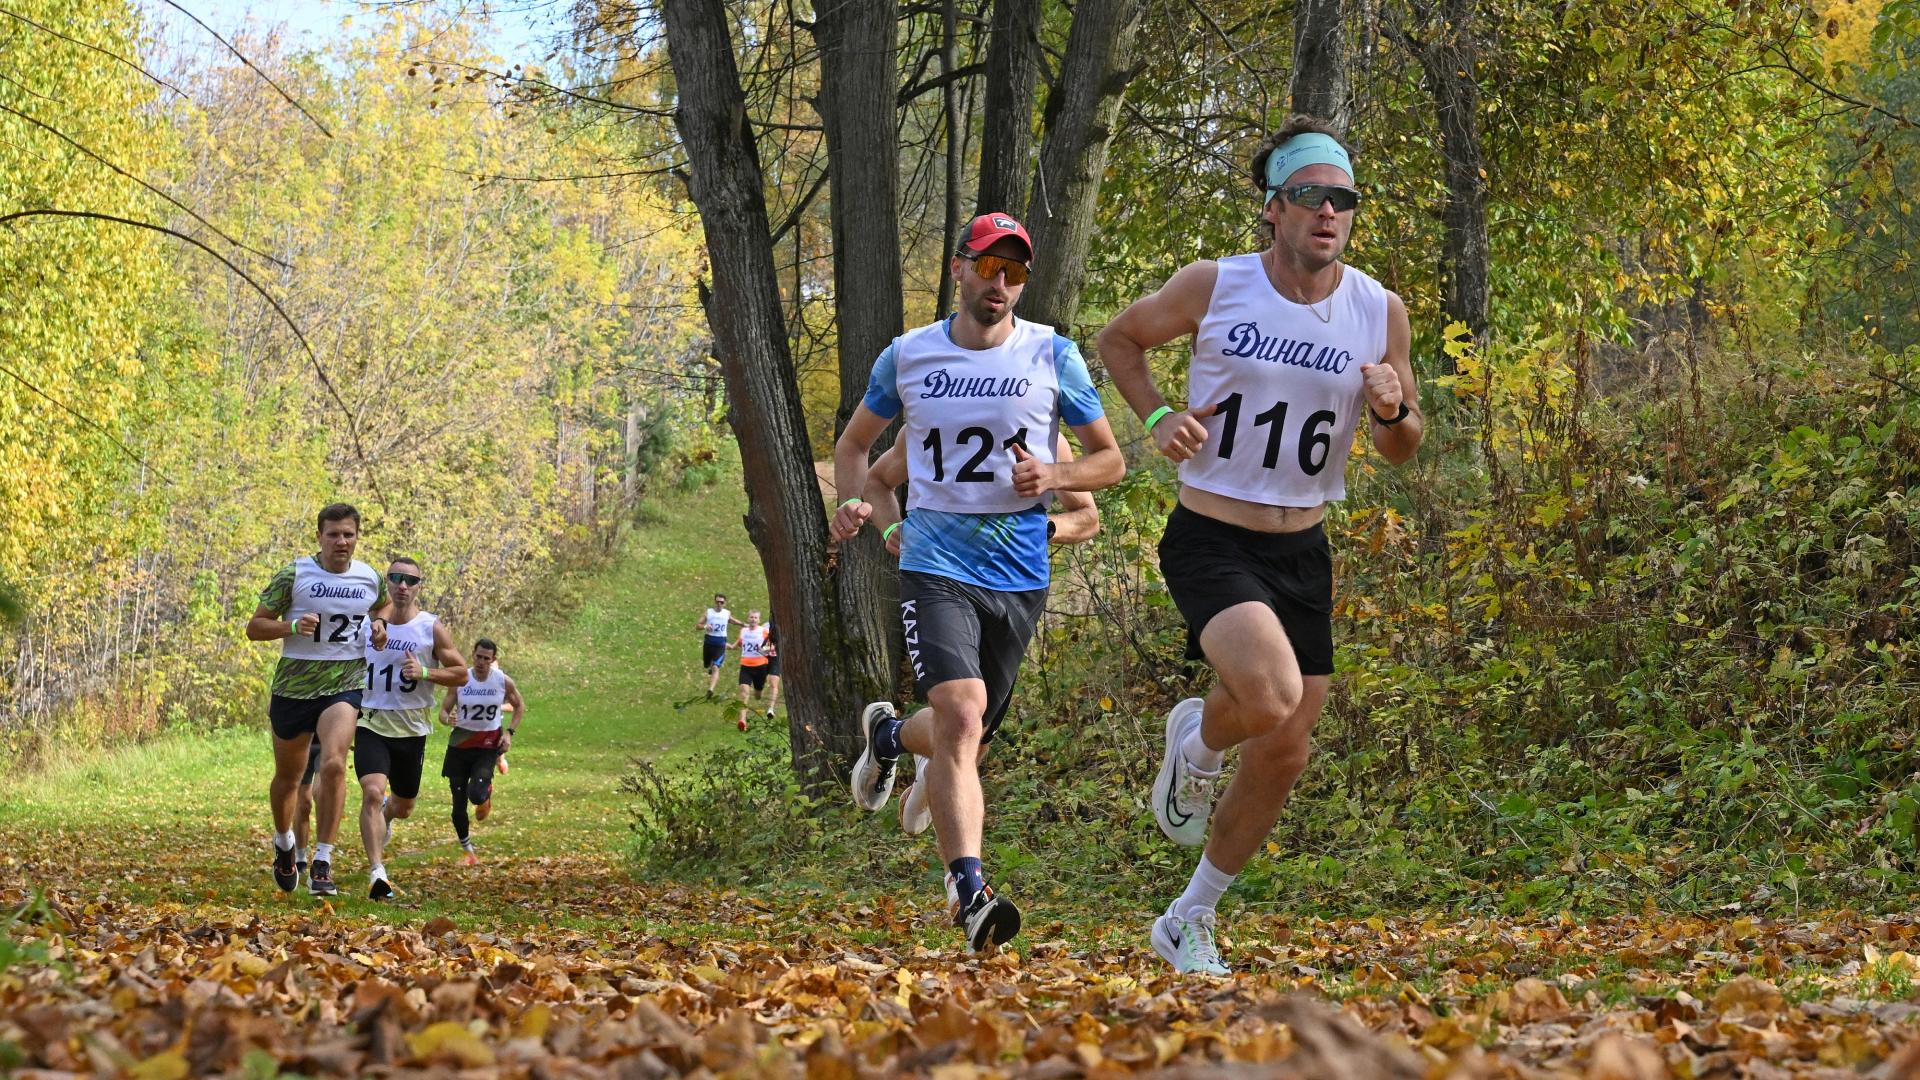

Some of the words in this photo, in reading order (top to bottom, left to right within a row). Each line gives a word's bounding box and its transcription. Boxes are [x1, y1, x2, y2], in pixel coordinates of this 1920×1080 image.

[1222, 321, 1353, 374] Динамо
[920, 369, 1033, 399] Динамо
[1212, 392, 1336, 477] 116
[309, 582, 366, 600] Динамо
[313, 613, 365, 643] 127
[901, 599, 926, 680] KAZAN
[461, 703, 498, 721] 129
